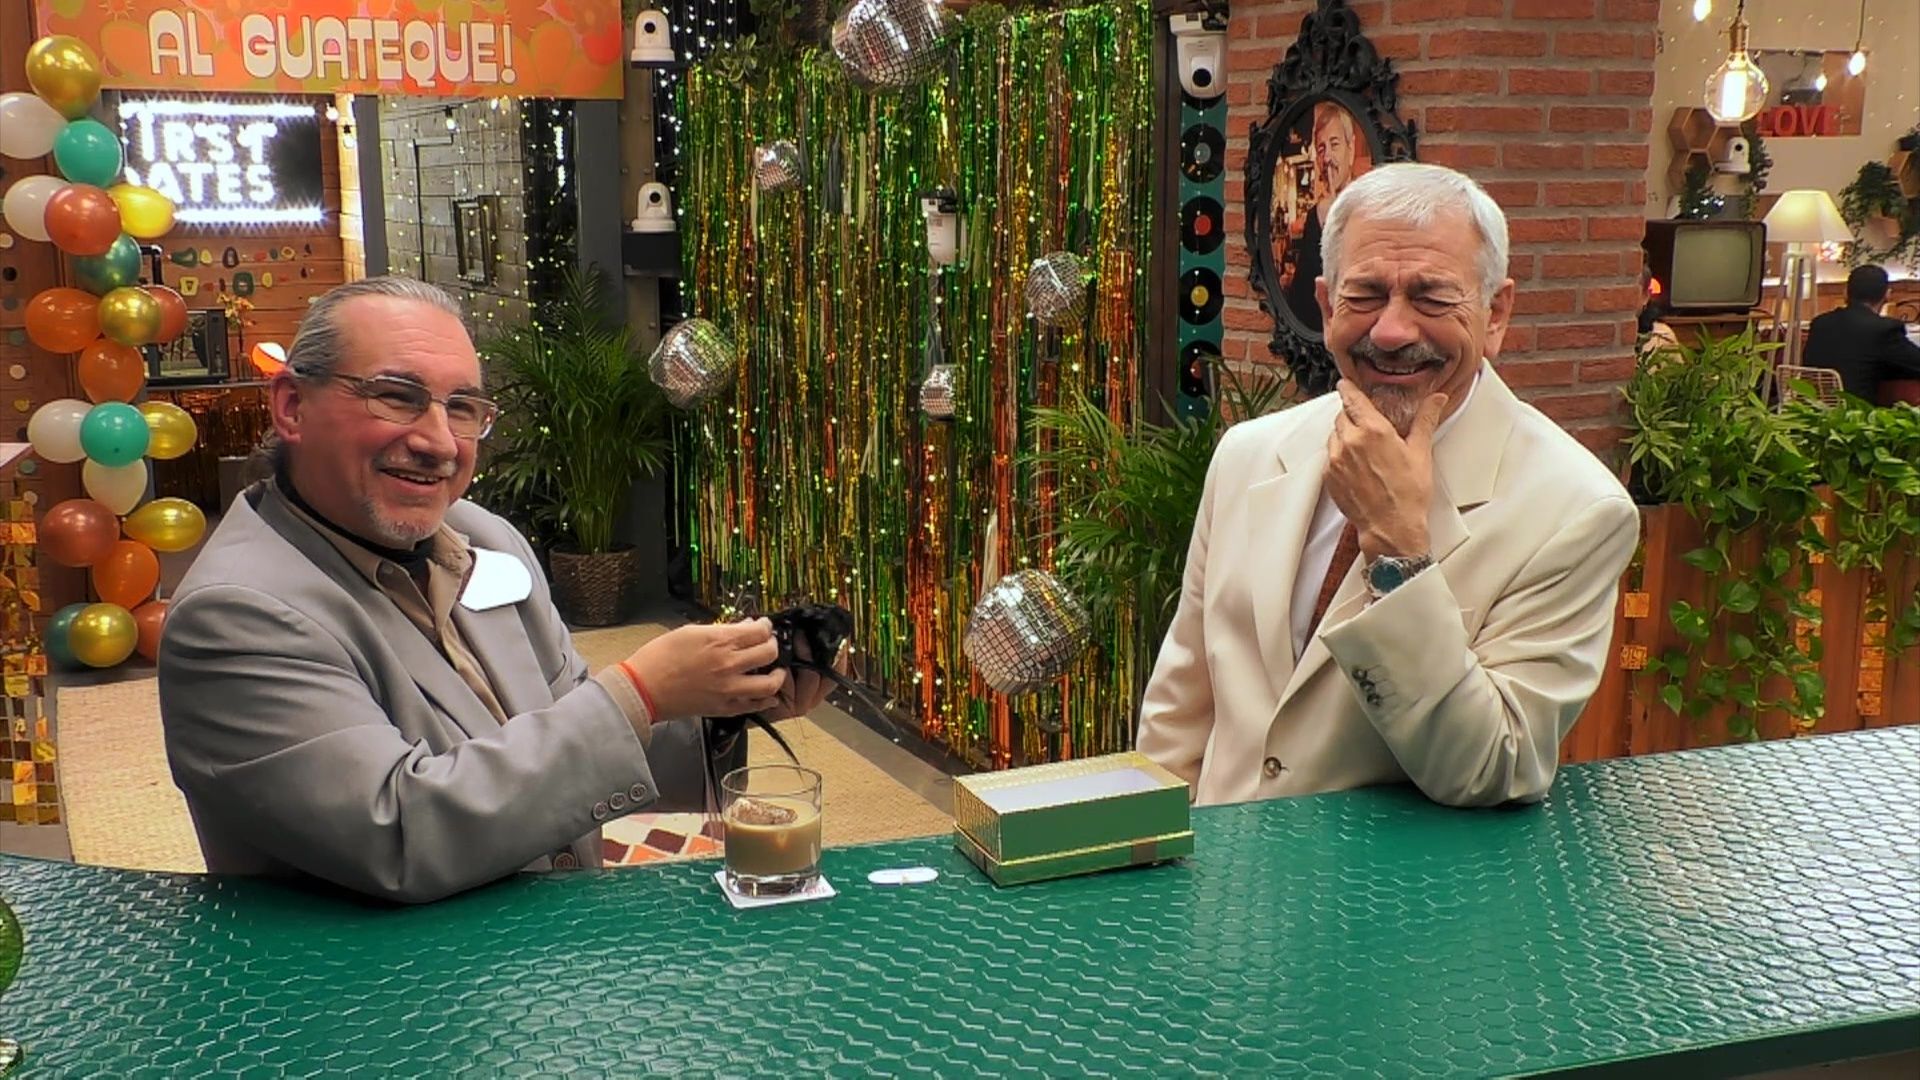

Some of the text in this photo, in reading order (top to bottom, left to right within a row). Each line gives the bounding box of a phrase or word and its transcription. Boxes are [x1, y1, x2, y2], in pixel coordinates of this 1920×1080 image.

[147, 9, 517, 88] AL GUATEQUE!
[121, 107, 279, 163] IRST
[1756, 104, 1842, 137] LOVE
